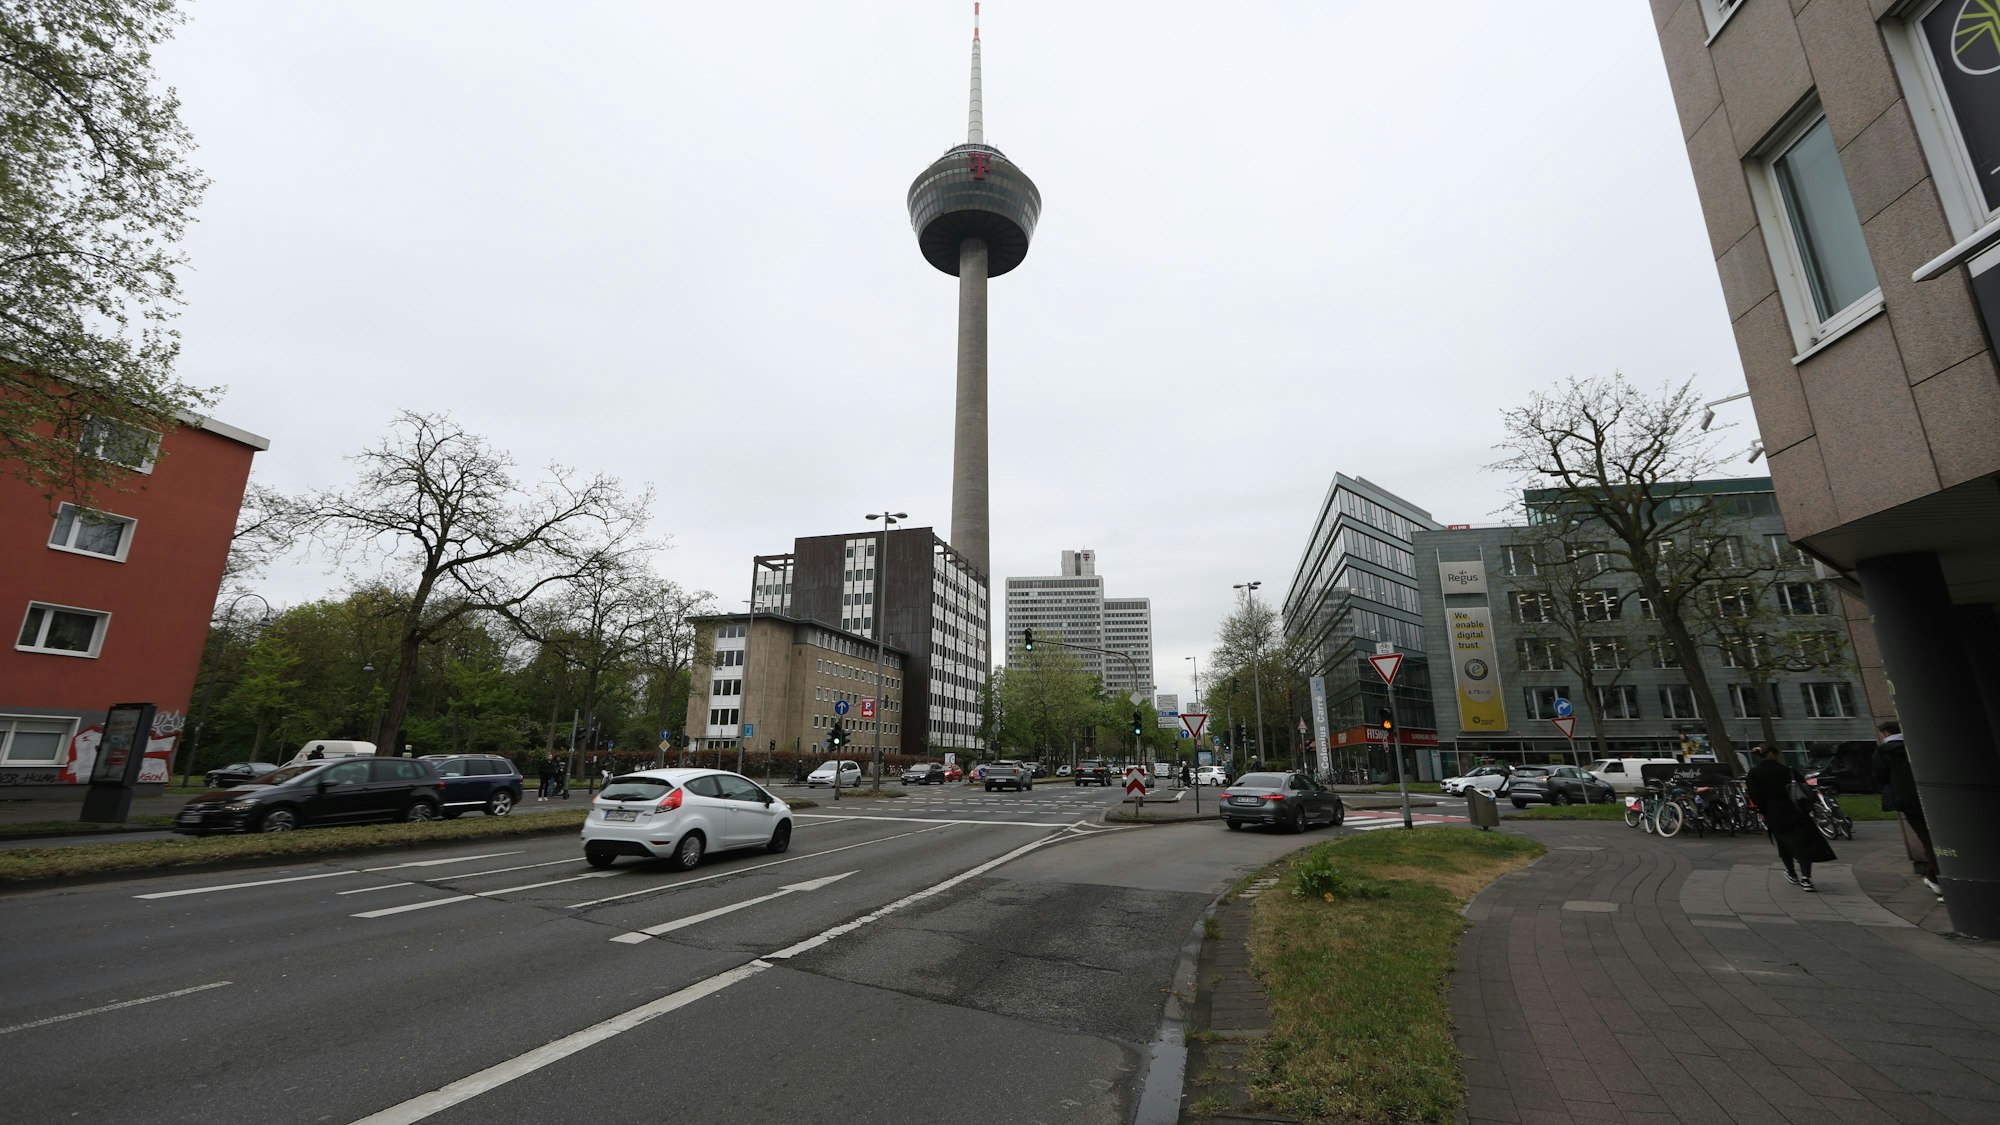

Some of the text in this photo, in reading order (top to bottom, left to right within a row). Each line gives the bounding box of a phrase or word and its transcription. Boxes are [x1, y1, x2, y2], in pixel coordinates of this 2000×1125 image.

[968, 152, 992, 180] T
[1447, 573, 1478, 585] Regus
[1457, 631, 1484, 639] digital
[1458, 641, 1479, 649] trust
[1315, 696, 1329, 769] Colonius Carré
